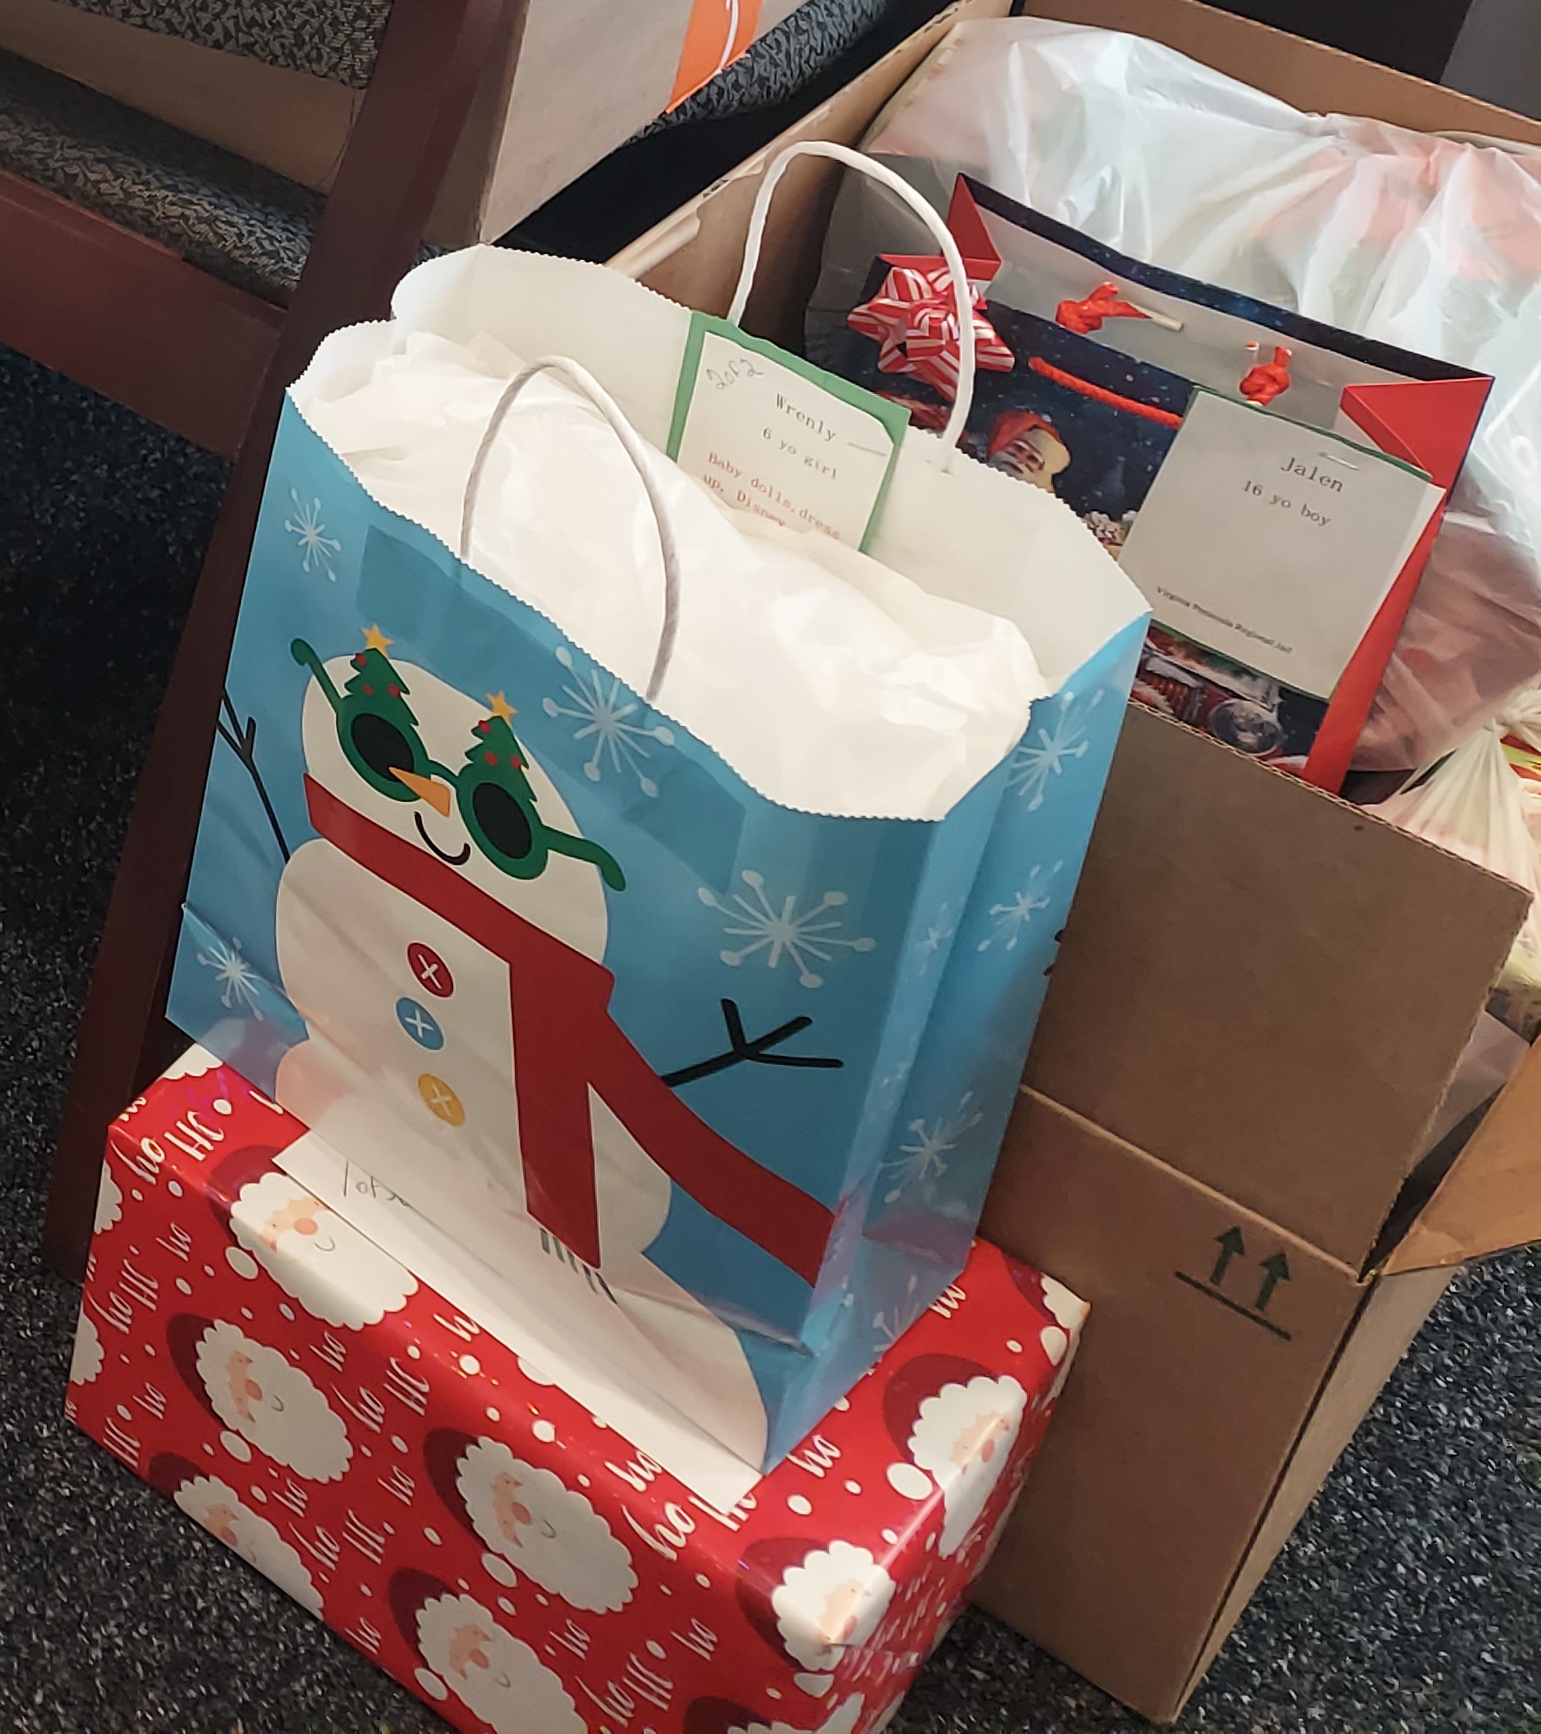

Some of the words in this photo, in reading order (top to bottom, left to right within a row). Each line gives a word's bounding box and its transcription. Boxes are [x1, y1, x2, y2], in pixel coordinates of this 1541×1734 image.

[775, 393, 837, 442] Wrenly
[708, 451, 743, 480] Baby
[762, 427, 772, 440] 6
[779, 440, 797, 456] yo
[803, 455, 838, 480] girl
[1280, 456, 1344, 494] Jalen
[703, 473, 725, 493] up,
[1241, 479, 1264, 498] 16
[1269, 494, 1292, 509] yo
[1299, 502, 1332, 528] boy
[111, 1136, 166, 1184] ho
[332, 1384, 386, 1434] ho
[604, 1449, 663, 1492] ho
[788, 1434, 841, 1478] ho
[621, 1502, 696, 1561] ho
